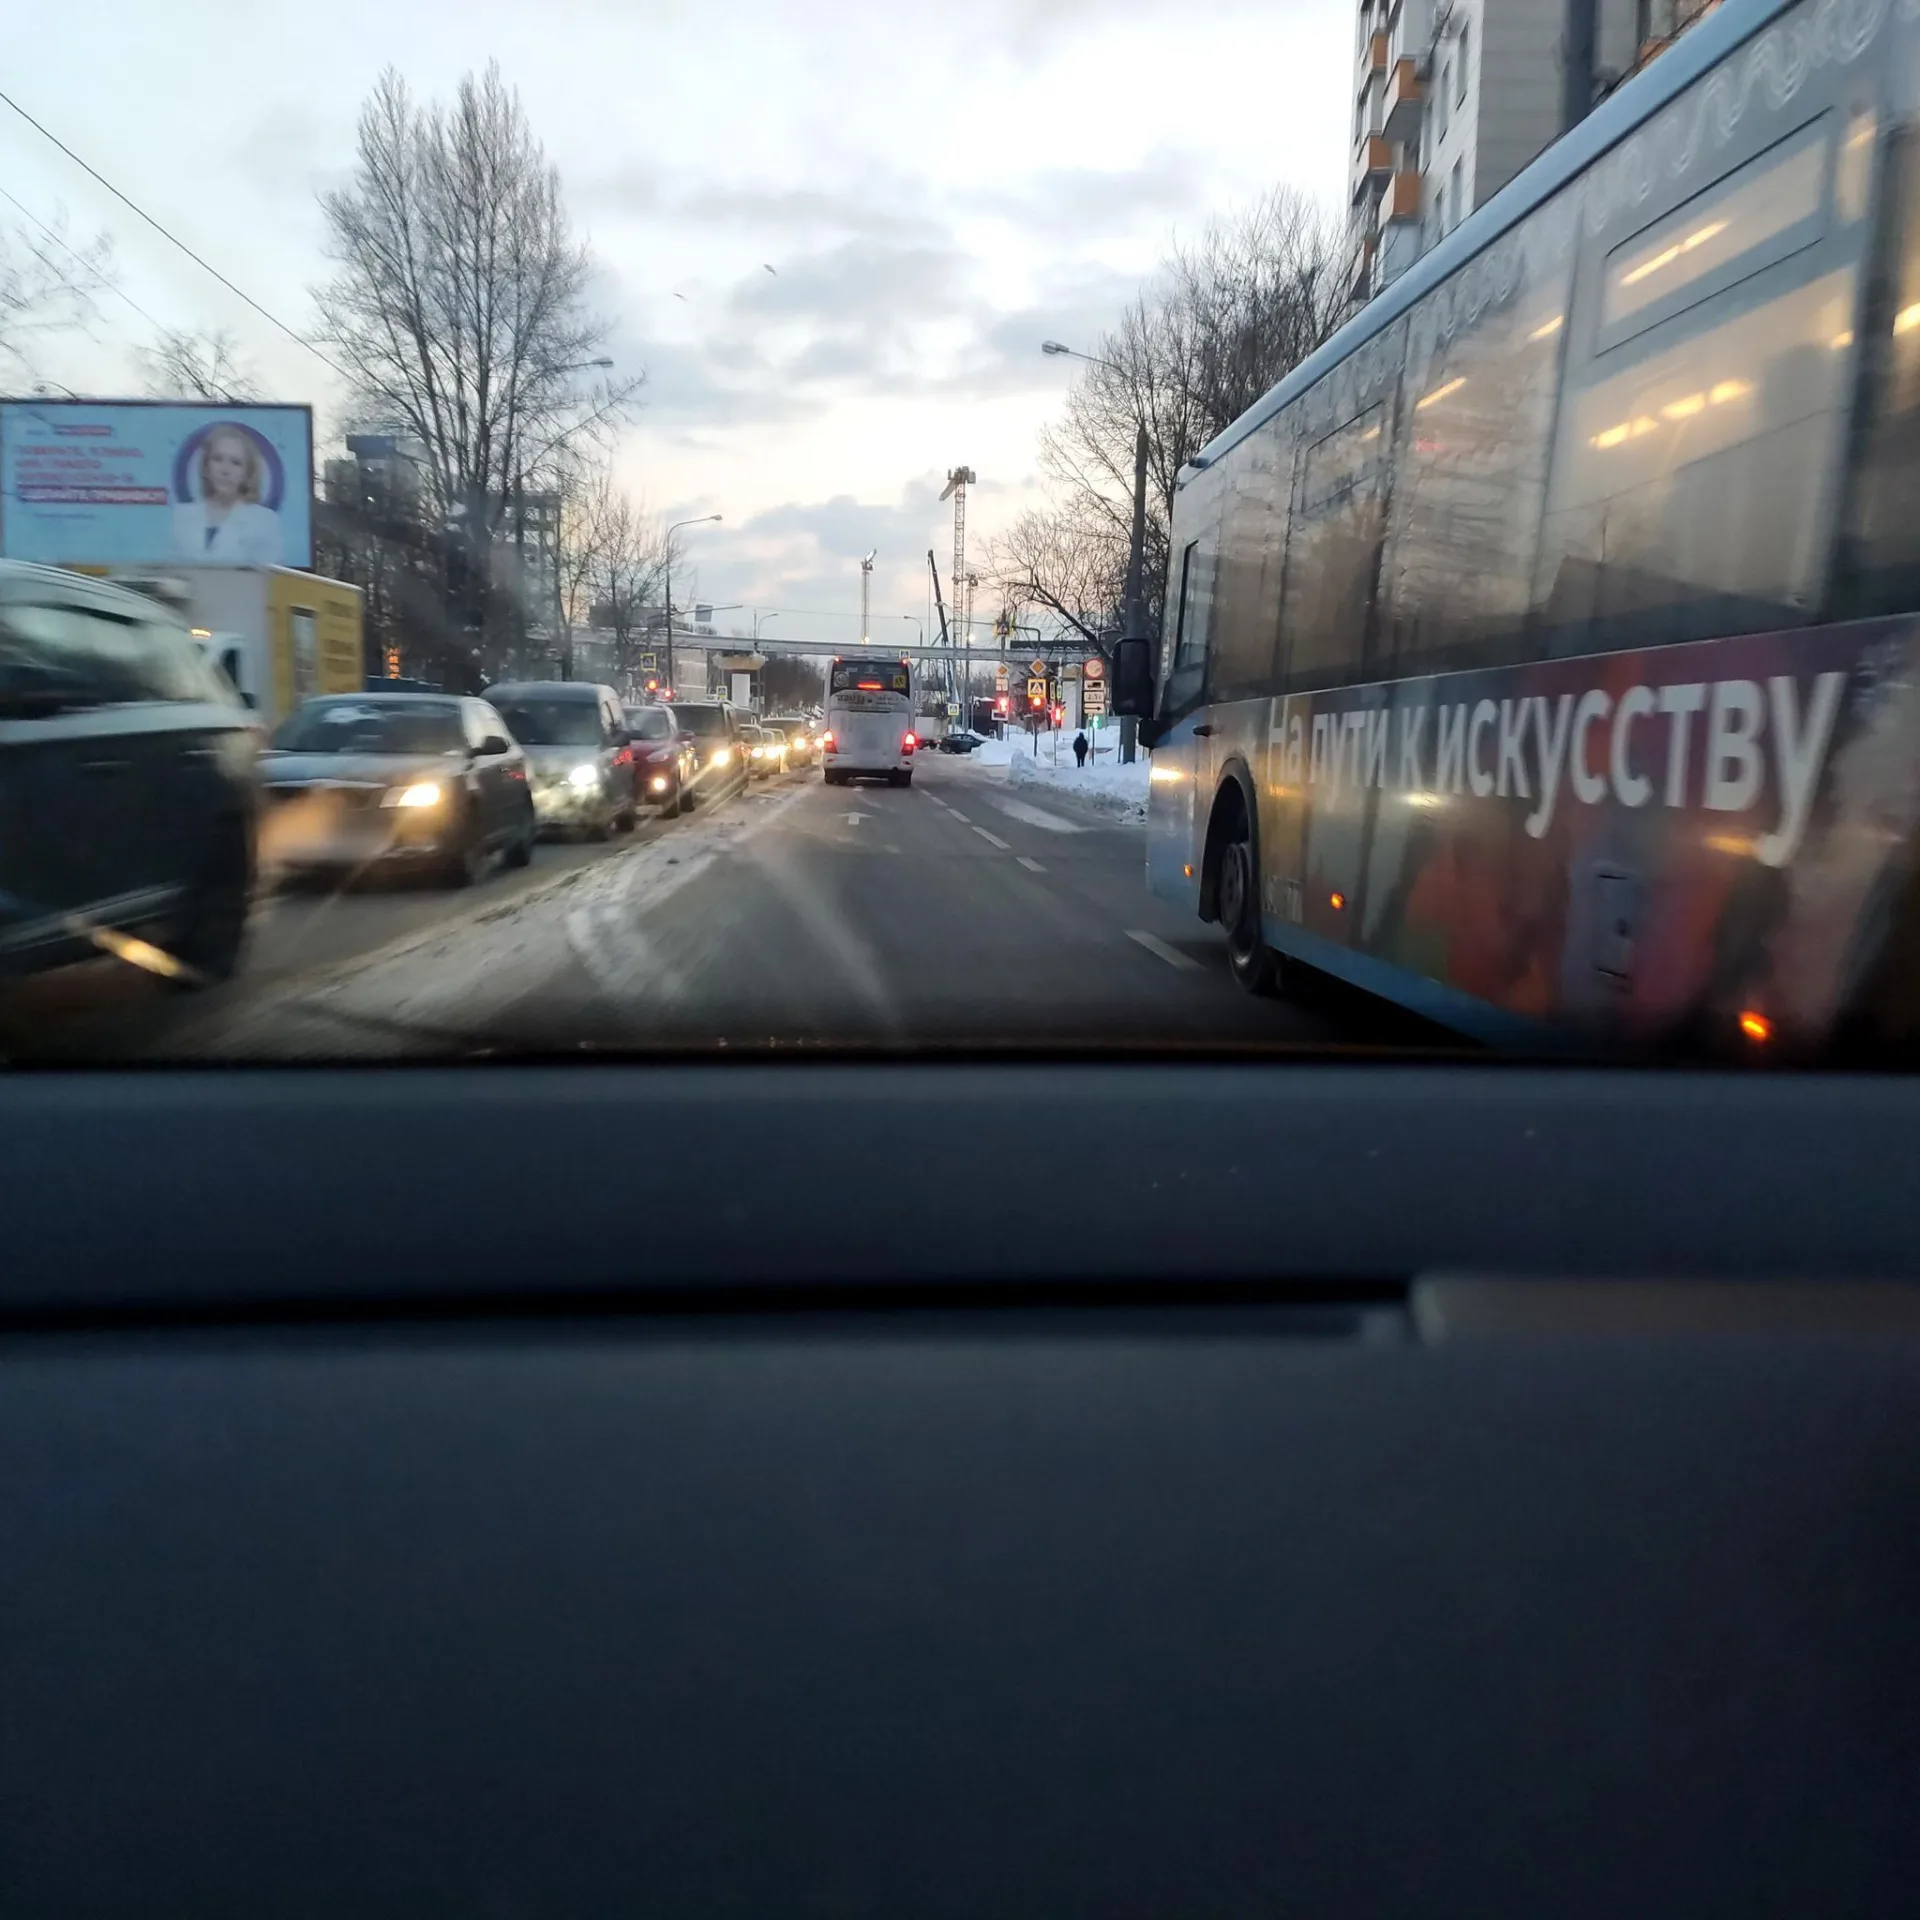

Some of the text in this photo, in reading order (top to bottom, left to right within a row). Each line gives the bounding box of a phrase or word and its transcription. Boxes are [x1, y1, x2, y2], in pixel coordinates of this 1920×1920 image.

[1266, 672, 1847, 867] На пути к искусству
